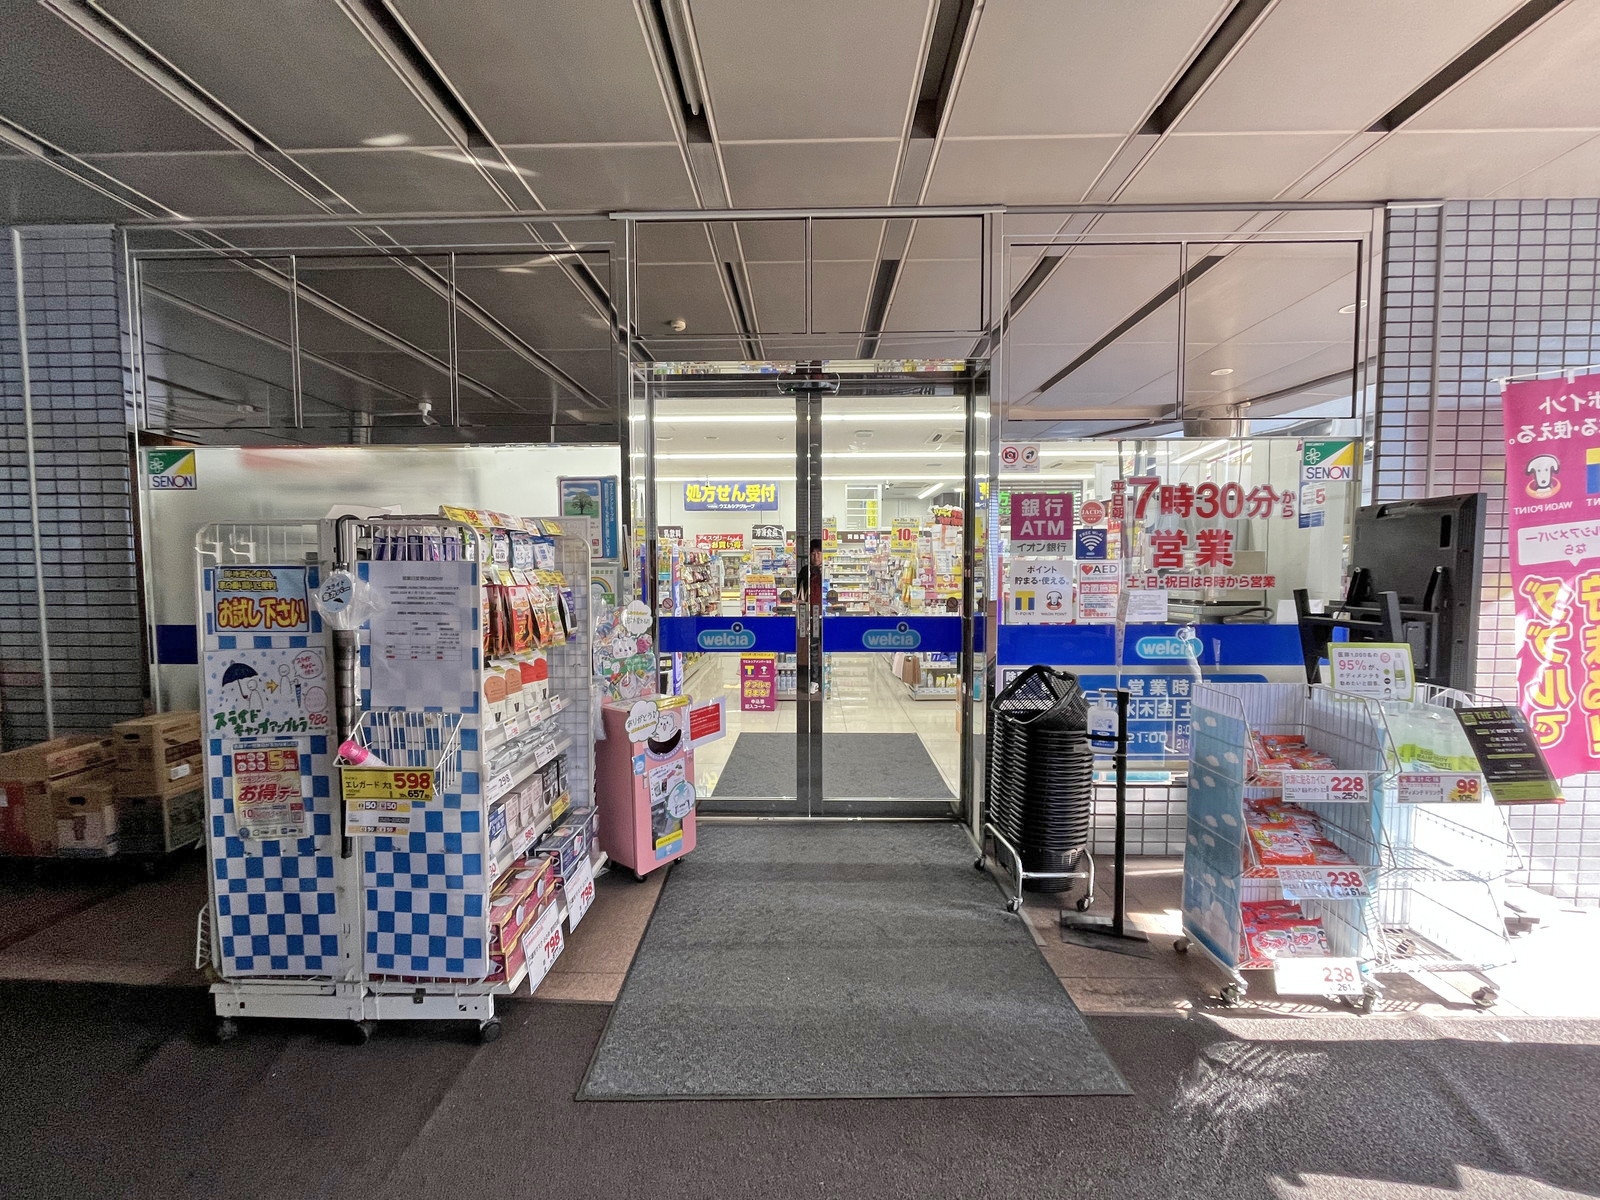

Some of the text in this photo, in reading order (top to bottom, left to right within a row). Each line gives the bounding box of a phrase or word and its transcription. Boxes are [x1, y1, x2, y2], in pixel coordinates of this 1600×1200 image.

[1306, 466, 1350, 480] SENON
[152, 475, 193, 488] SENON
[686, 484, 776, 503] 処方せん受付
[1111, 480, 1126, 520] 平日朝
[1127, 476, 1280, 519] 7時30分
[1021, 498, 1063, 517] 銀行
[1282, 491, 1295, 518] から
[896, 528, 911, 540] 10
[1020, 520, 1064, 536] ATM
[1016, 543, 1067, 553] イオン銀行
[1150, 529, 1235, 569] 営業
[1026, 565, 1057, 574] ポイント
[1093, 564, 1118, 574] AED
[1014, 576, 1070, 586] 貯まる・使える。
[1127, 575, 1276, 589] 土・日・祝日は8時から営業
[217, 596, 308, 629] お試し下さい
[703, 633, 748, 647] welcia
[868, 632, 914, 647] welcia
[1140, 702, 1155, 717] 木
[1158, 702, 1173, 717] 金
[1473, 711, 1494, 720] THE
[213, 709, 261, 730] スライド
[308, 713, 328, 725] 980
[345, 781, 380, 789] エレガード
[393, 772, 431, 790] 598
[1330, 776, 1365, 792] 228
[1456, 779, 1479, 795] 98
[238, 784, 302, 804] お得デー
[407, 789, 425, 799] 657
[1342, 792, 1359, 800] 250
[365, 801, 377, 810] 50
[1327, 871, 1363, 887] 238
[581, 881, 593, 902] 798
[544, 929, 561, 959] 798
[1323, 967, 1355, 982] 238
